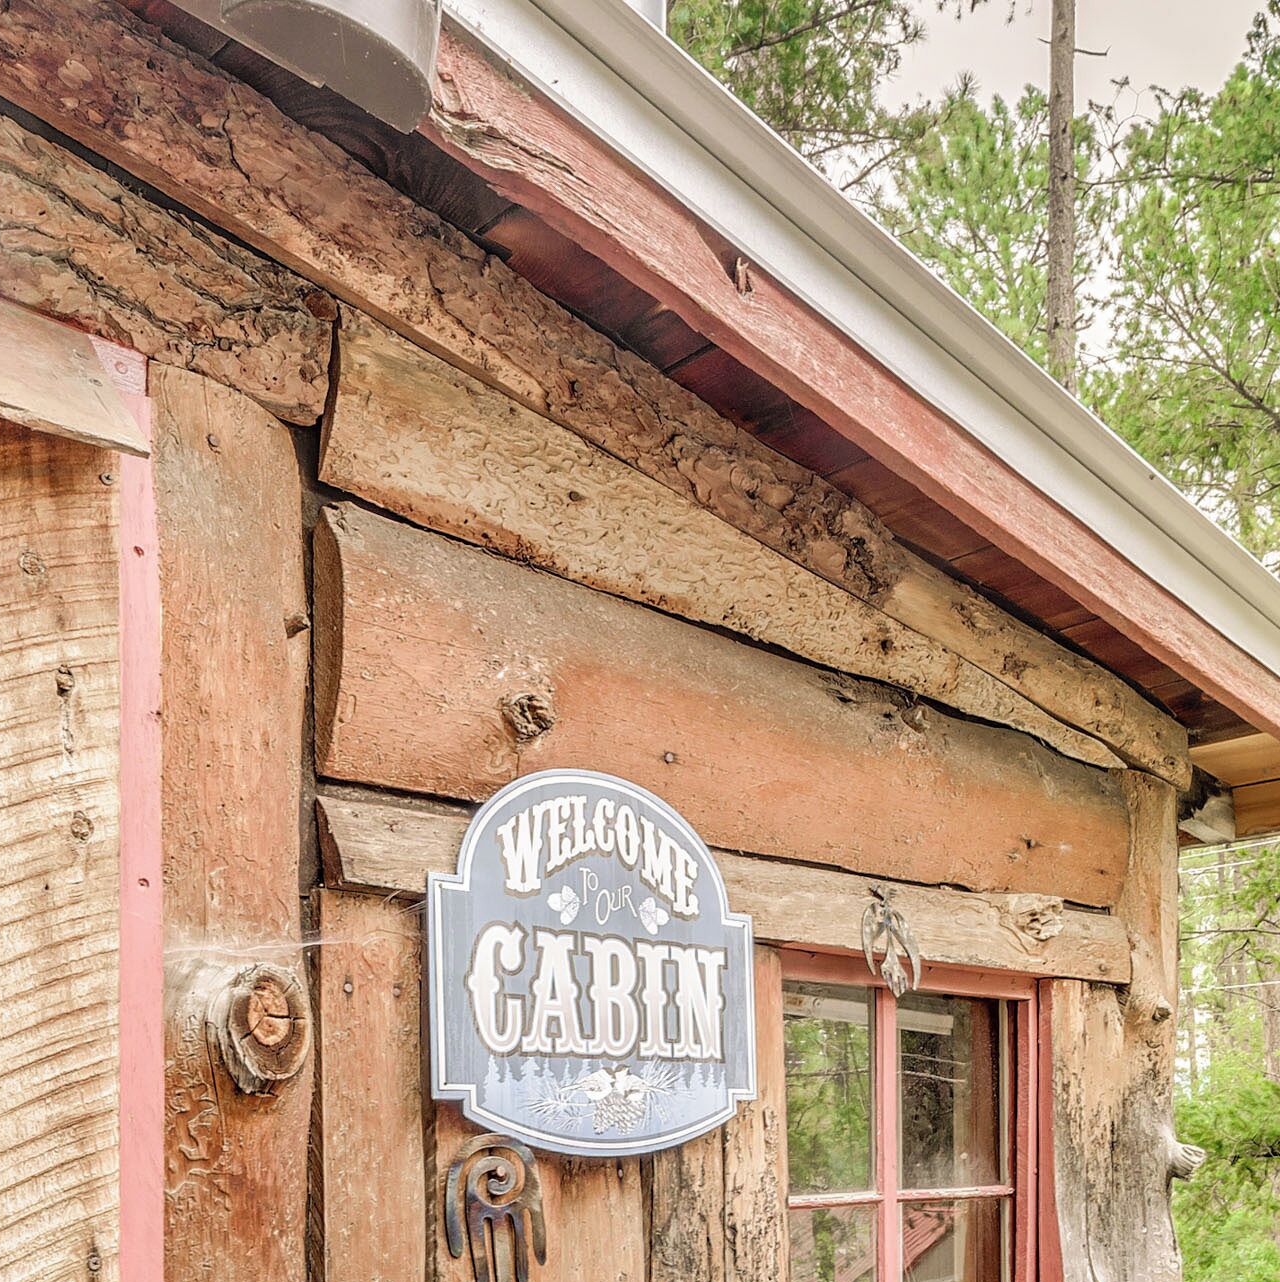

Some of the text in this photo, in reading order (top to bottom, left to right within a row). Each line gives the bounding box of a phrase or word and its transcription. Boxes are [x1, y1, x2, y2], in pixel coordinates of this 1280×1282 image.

[496, 795, 700, 918] WELCOME
[579, 867, 638, 925] TO OUR
[466, 923, 726, 1061] CABIN
